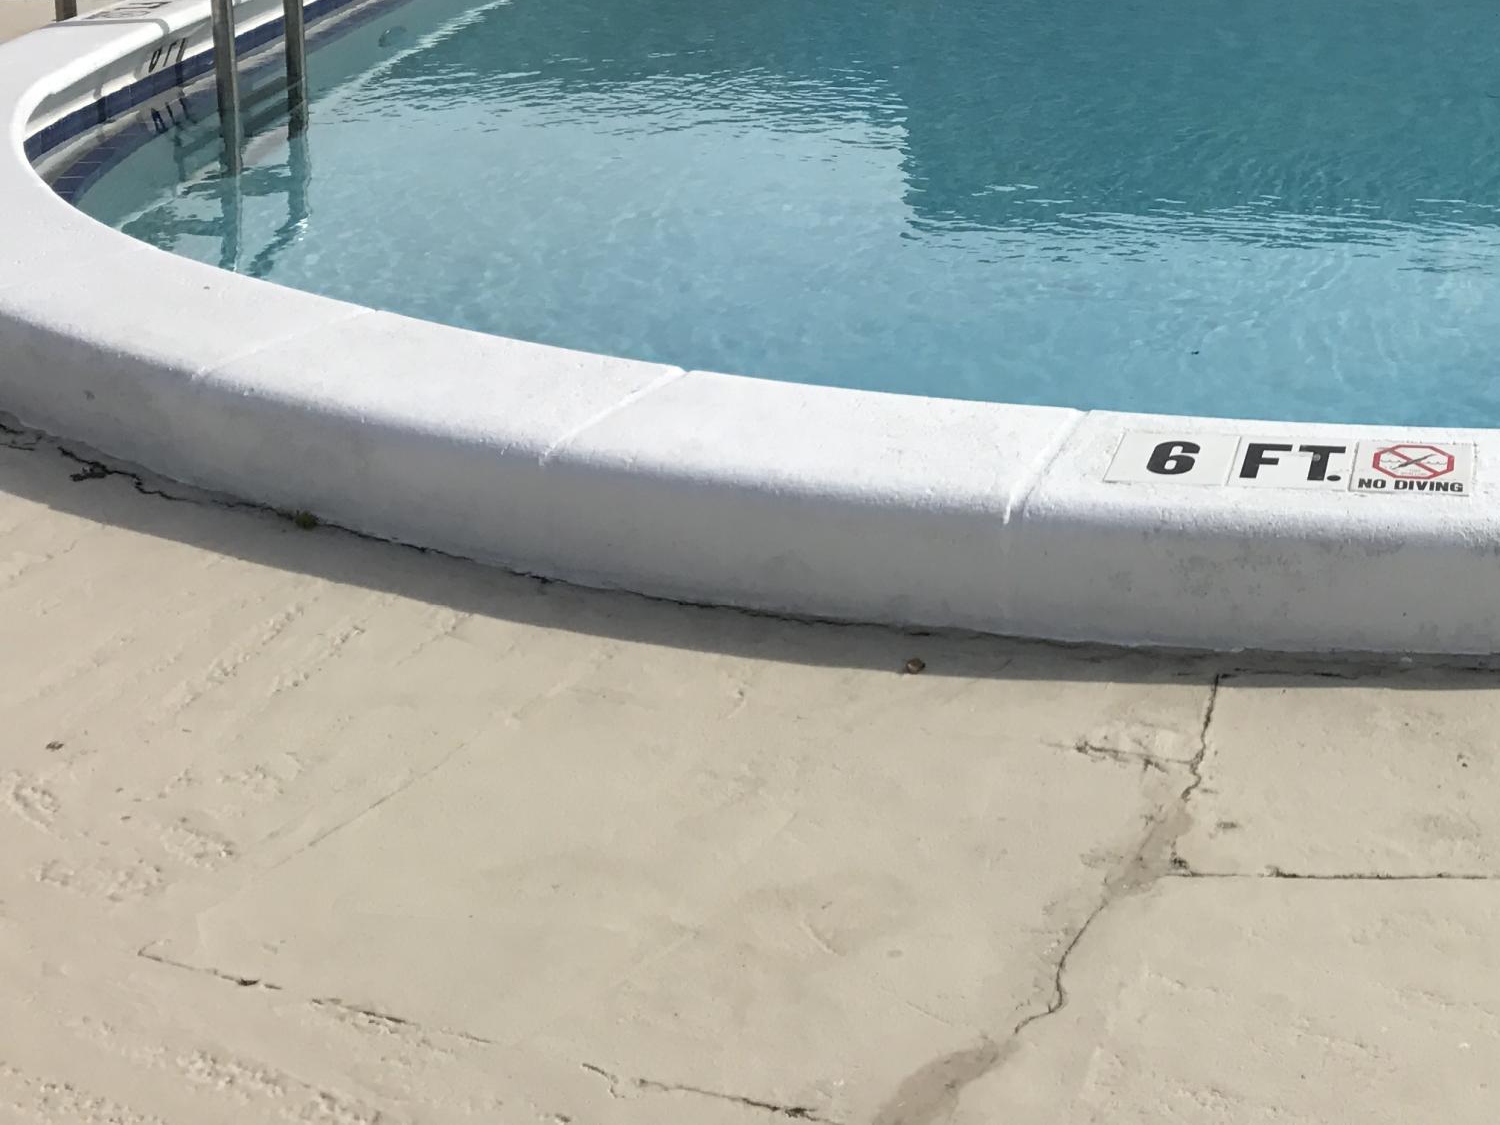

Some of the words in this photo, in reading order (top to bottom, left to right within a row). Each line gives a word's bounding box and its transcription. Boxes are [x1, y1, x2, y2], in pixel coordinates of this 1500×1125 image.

[1146, 440, 1201, 475] 6
[1239, 442, 1346, 482] FT.
[1357, 477, 1389, 491] NO
[1394, 478, 1464, 493] DIVING
